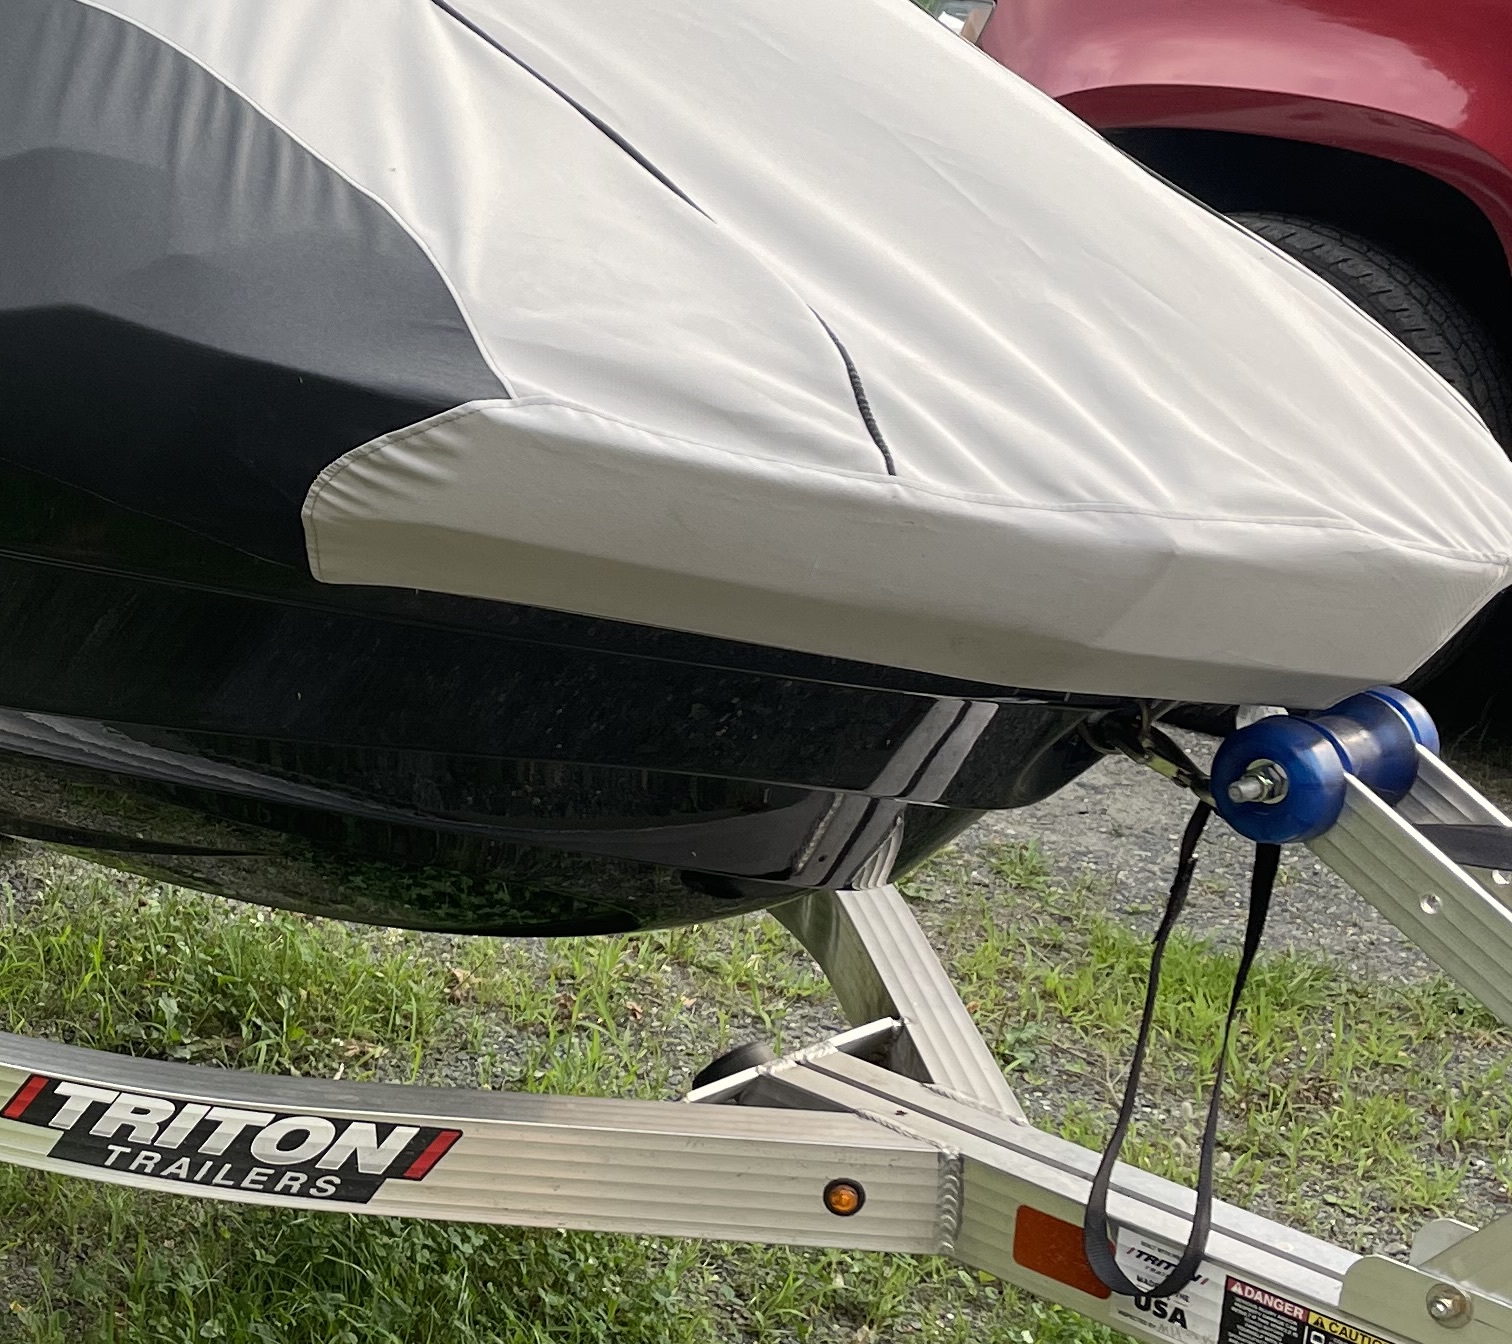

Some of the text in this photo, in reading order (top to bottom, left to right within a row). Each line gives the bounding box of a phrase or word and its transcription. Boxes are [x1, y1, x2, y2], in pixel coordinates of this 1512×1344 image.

[46, 1081, 420, 1175] TRITON
[105, 1144, 342, 1198] TRAILERS
[1134, 1295, 1188, 1329] USA
[1244, 1286, 1304, 1320] DANGER
